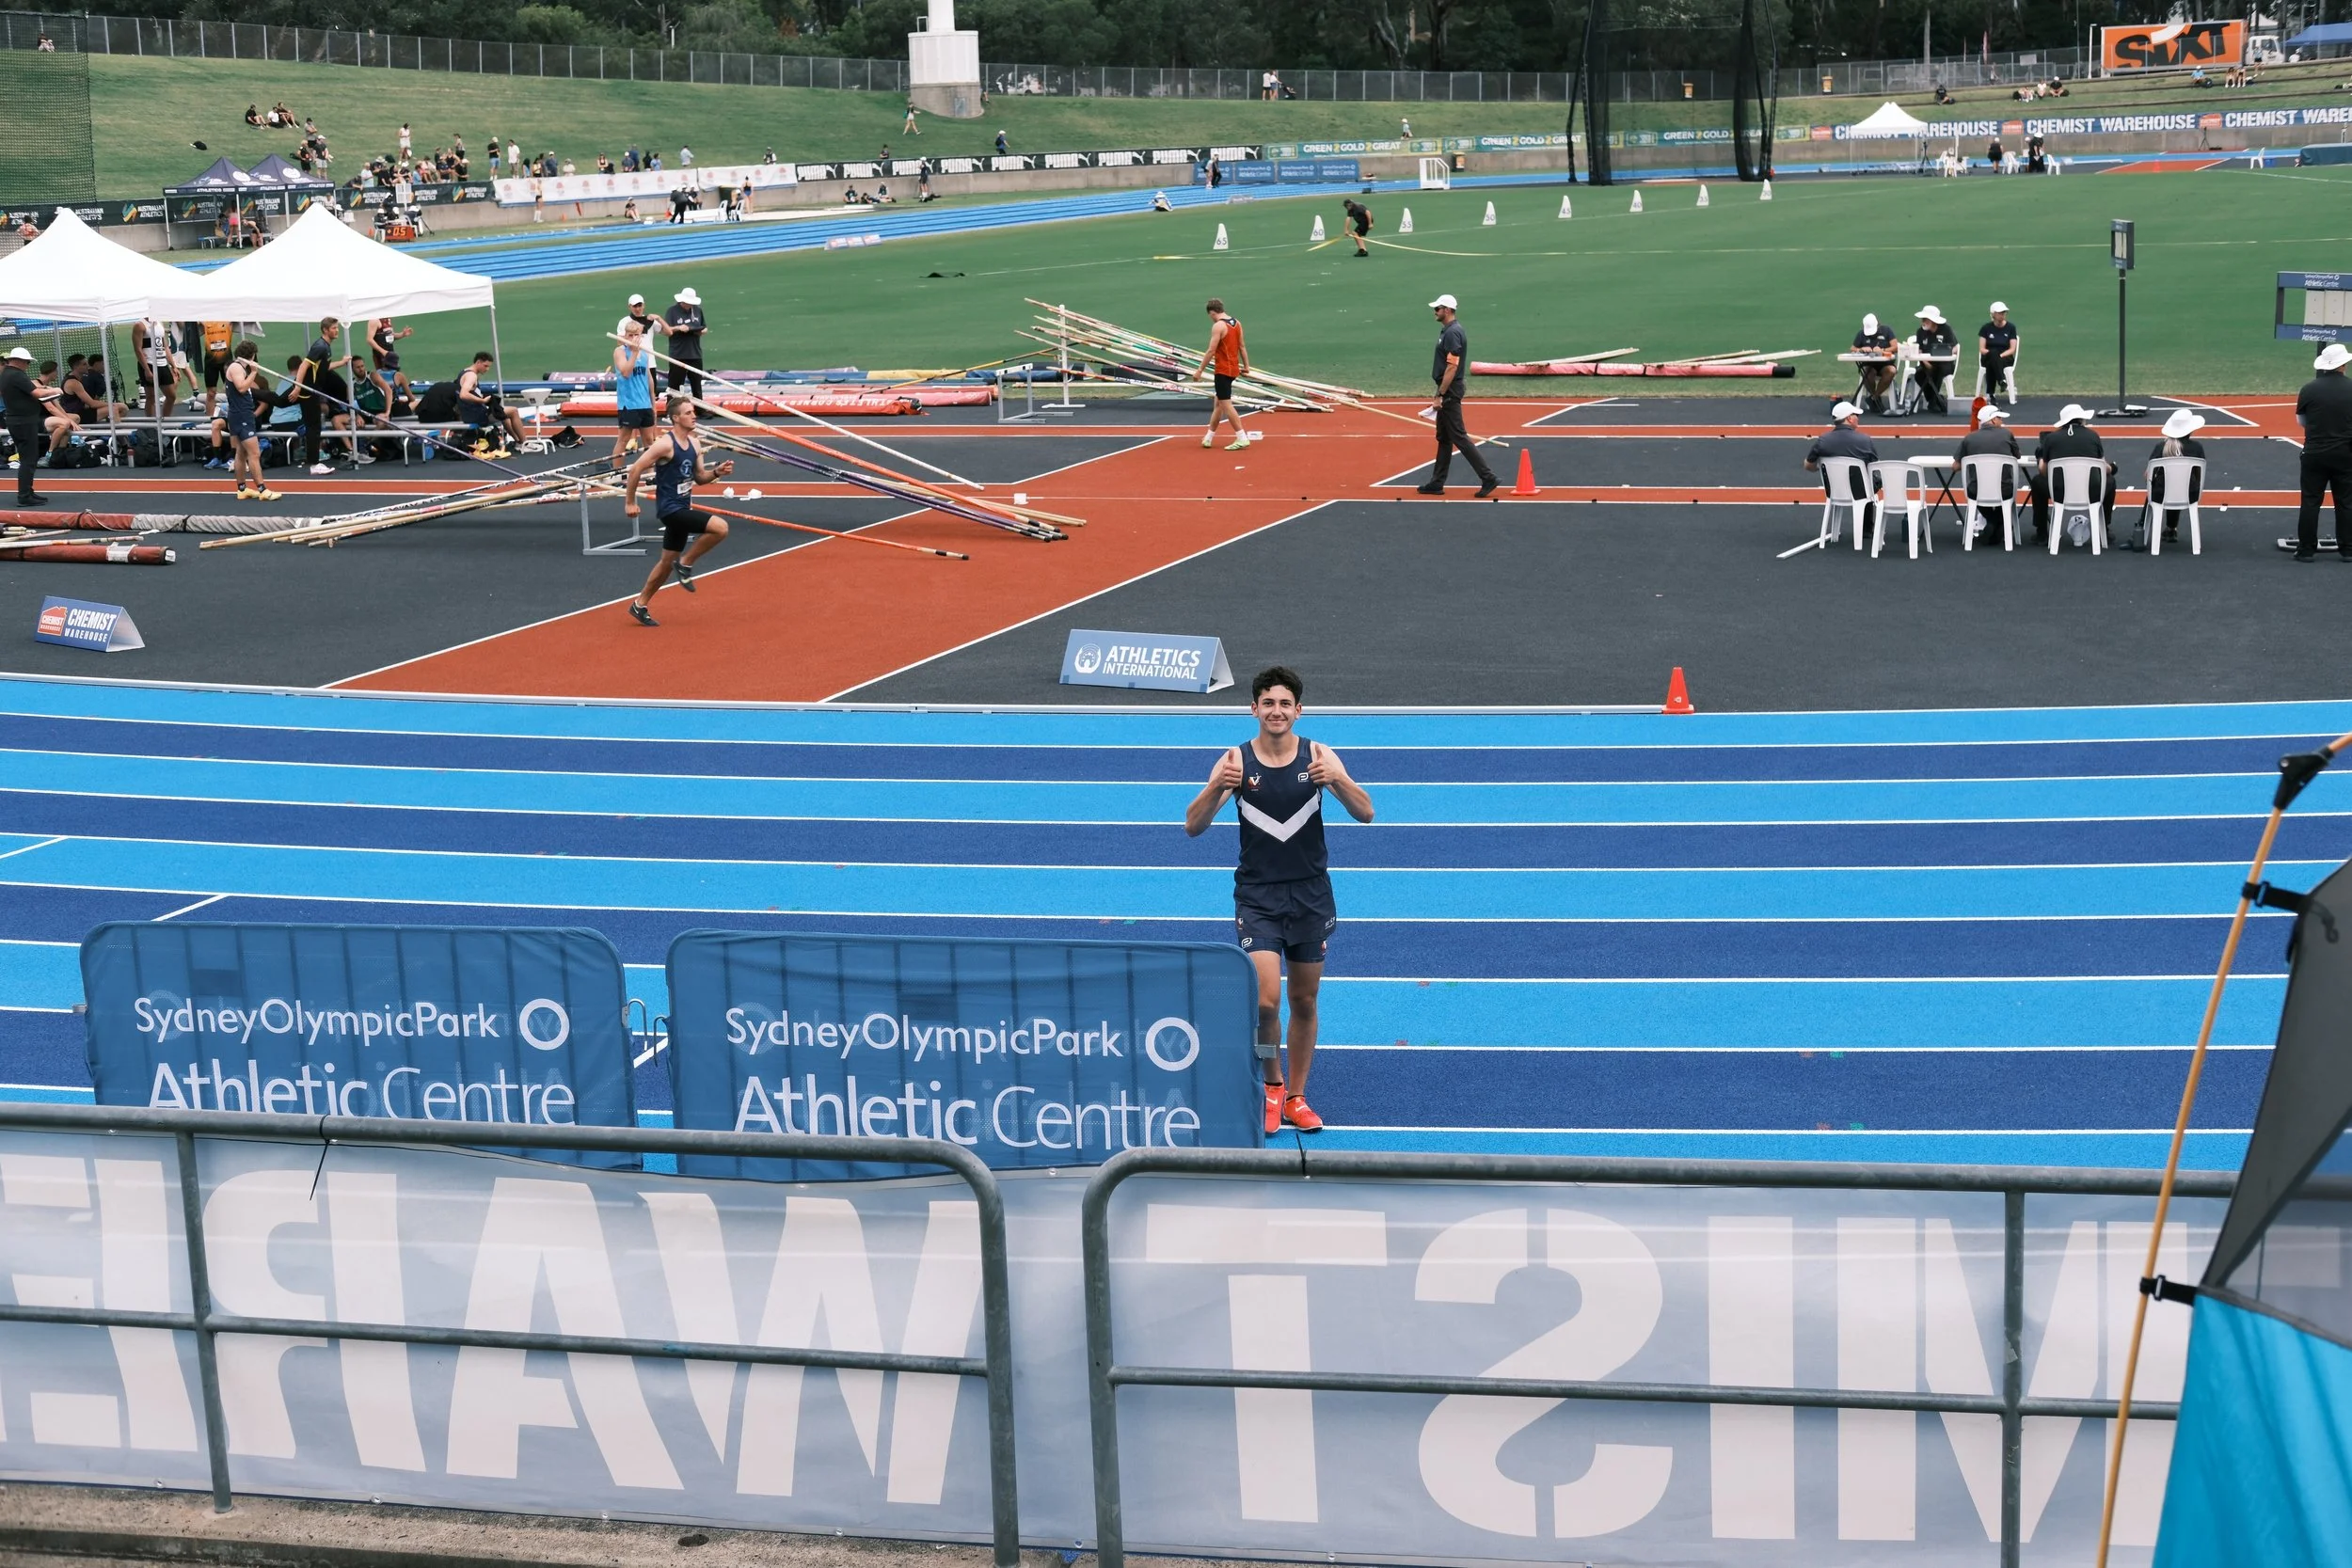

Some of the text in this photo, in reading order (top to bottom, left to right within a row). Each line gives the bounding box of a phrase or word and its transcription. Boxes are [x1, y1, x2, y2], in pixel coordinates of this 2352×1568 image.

[2026, 118, 2095, 135] CHEMIST
[2100, 114, 2196, 132] WAREHOUSE
[2225, 110, 2296, 128] CHEMIST
[1482, 136, 1511, 146] GREEN
[1519, 135, 1544, 145] GOLD
[1552, 135, 1581, 144] GRAT
[1663, 130, 1694, 140] GREEN
[1703, 129, 1728, 139] GOLD
[1303, 144, 1332, 153] GREEN
[1341, 143, 1364, 152] GOLD
[1372, 141, 1401, 150] GREAT
[992, 156, 1024, 171] PUMA
[1045, 153, 1078, 168] PUMA
[1098, 151, 1132, 166] PUMA
[1152, 150, 1187, 164] PUMA
[798, 165, 827, 181] PUMA
[844, 163, 873, 179] PUMA
[942, 158, 972, 173] PUMA
[1313, 229, 1324, 237] 60
[1216, 237, 1227, 245] 65
[633, 366, 646, 376] NSW
[41, 614, 65, 626] CHEMIST
[68, 608, 117, 631] CHEMIST
[64, 627, 108, 643] WAREHOUSE
[1106, 645, 1201, 667] ATHLETICS
[1103, 661, 1198, 680] INTERNATIONAL
[134, 997, 500, 1046] SydneyOlympicPark
[725, 1007, 1122, 1064] SydneyOlympicPark
[148, 1057, 576, 1127] Athletic Centre
[734, 1073, 1200, 1150] Athletic Centre
